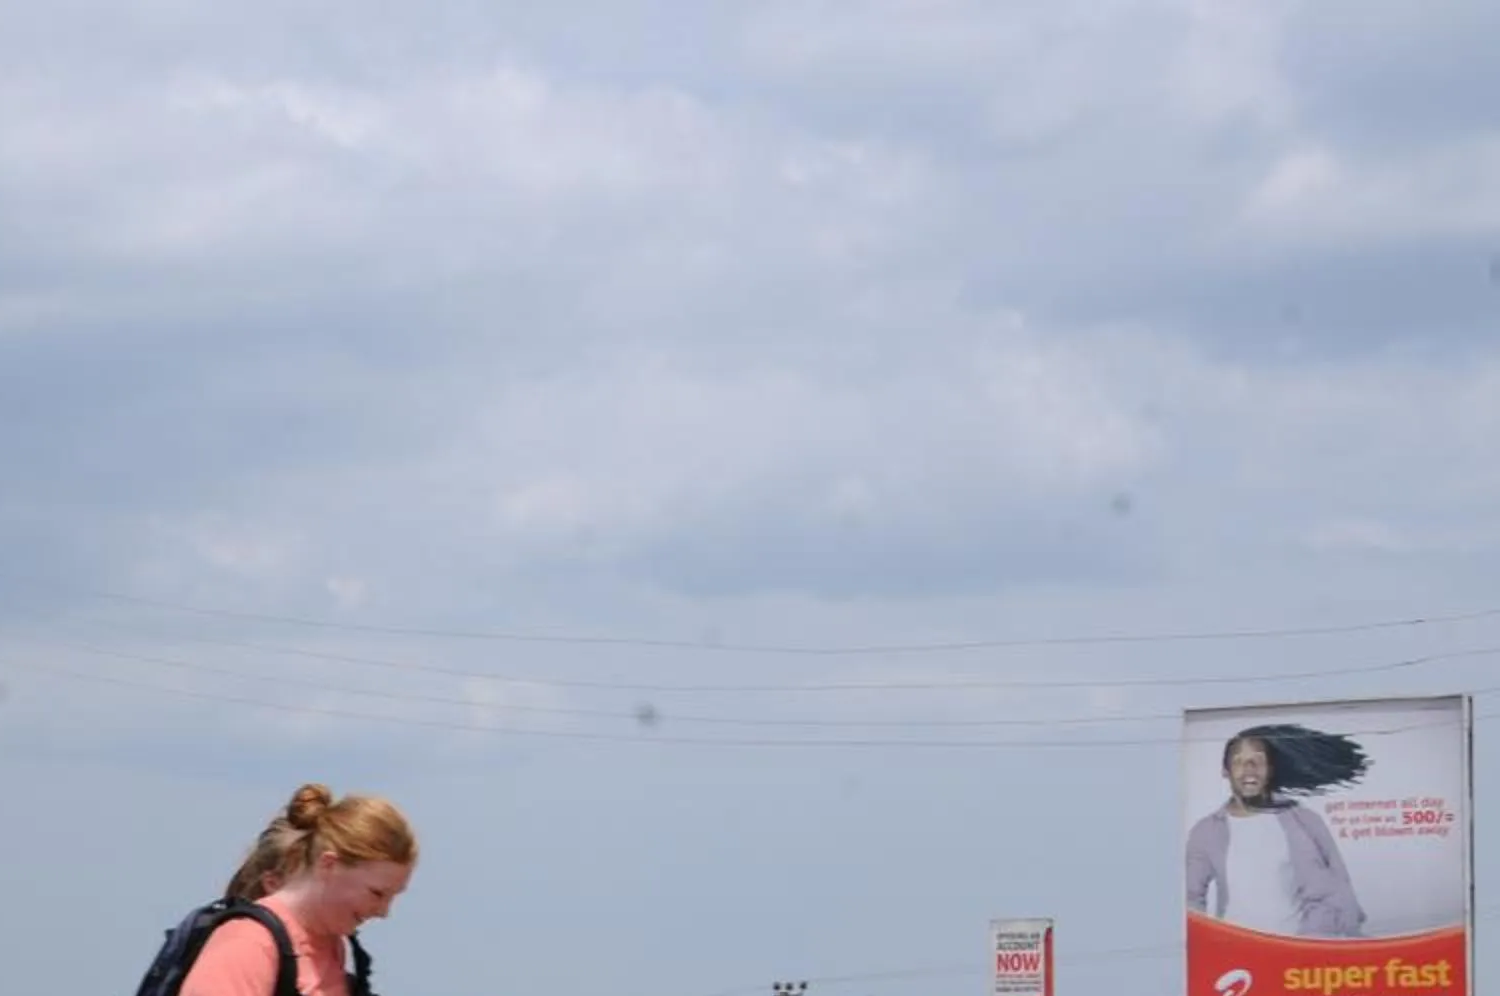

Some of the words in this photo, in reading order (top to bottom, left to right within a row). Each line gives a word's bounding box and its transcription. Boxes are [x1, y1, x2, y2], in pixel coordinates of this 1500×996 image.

[1402, 810, 1455, 825] 500/=
[997, 952, 1041, 972] NOW
[1284, 965, 1379, 996] super
[1385, 957, 1452, 988] fast
